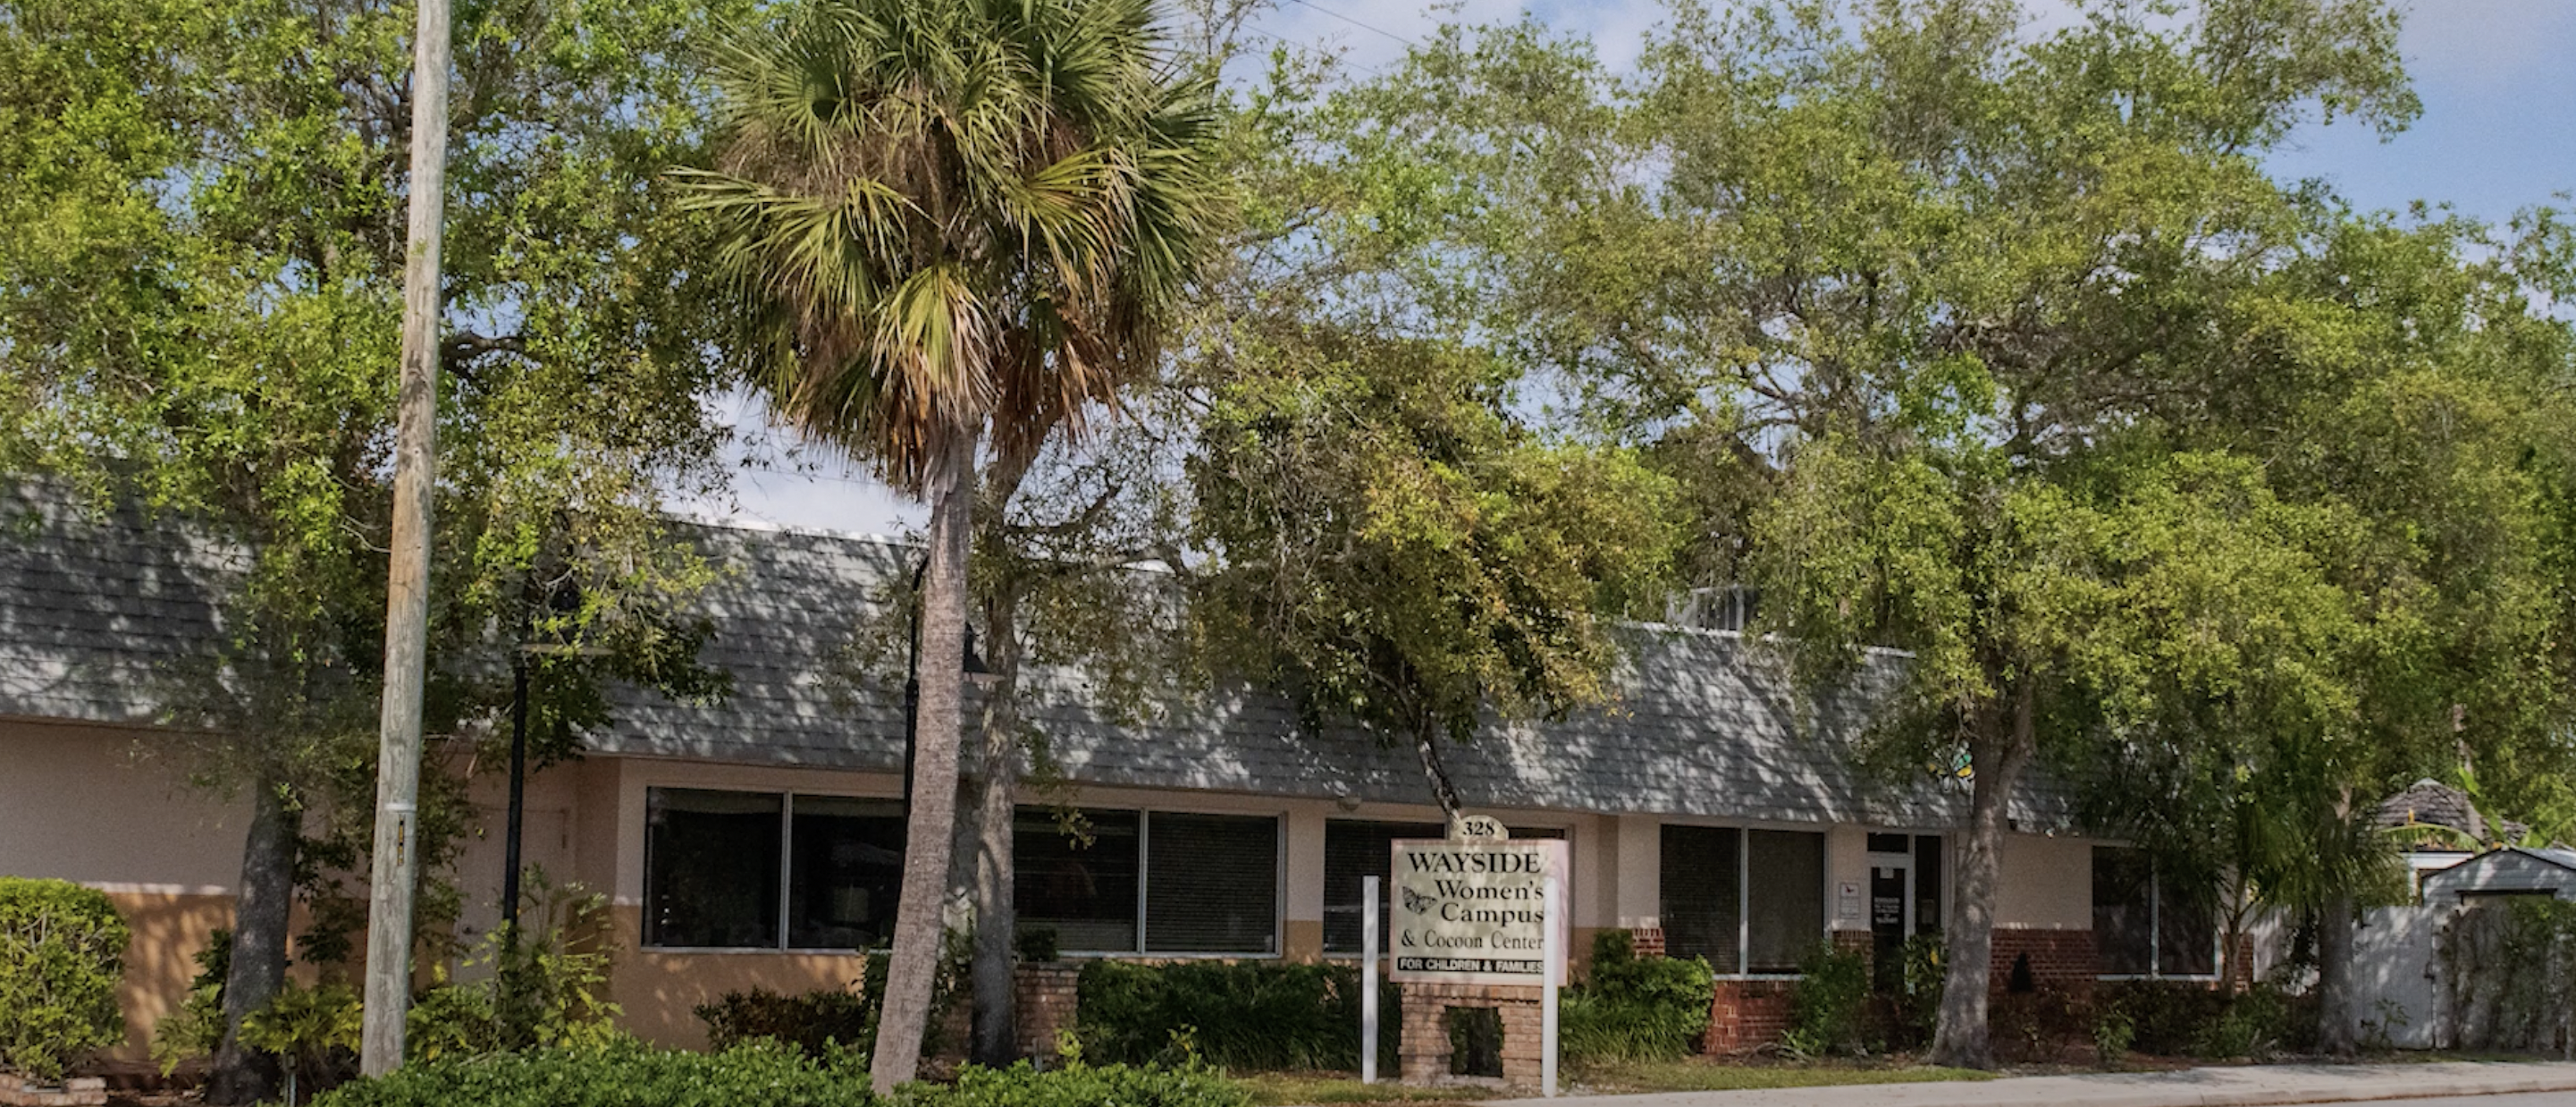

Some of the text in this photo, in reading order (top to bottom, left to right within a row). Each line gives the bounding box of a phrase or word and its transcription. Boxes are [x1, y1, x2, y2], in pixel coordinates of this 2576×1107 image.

[1463, 822, 1494, 836] 328
[1408, 852, 1541, 874] WAYSIDE
[1435, 879, 1544, 900] Women's
[1441, 901, 1544, 928] Campus
[1401, 929, 1544, 950] & Cocoon Center
[1400, 959, 1544, 973] FOR CHILDREN & FAMILIES
